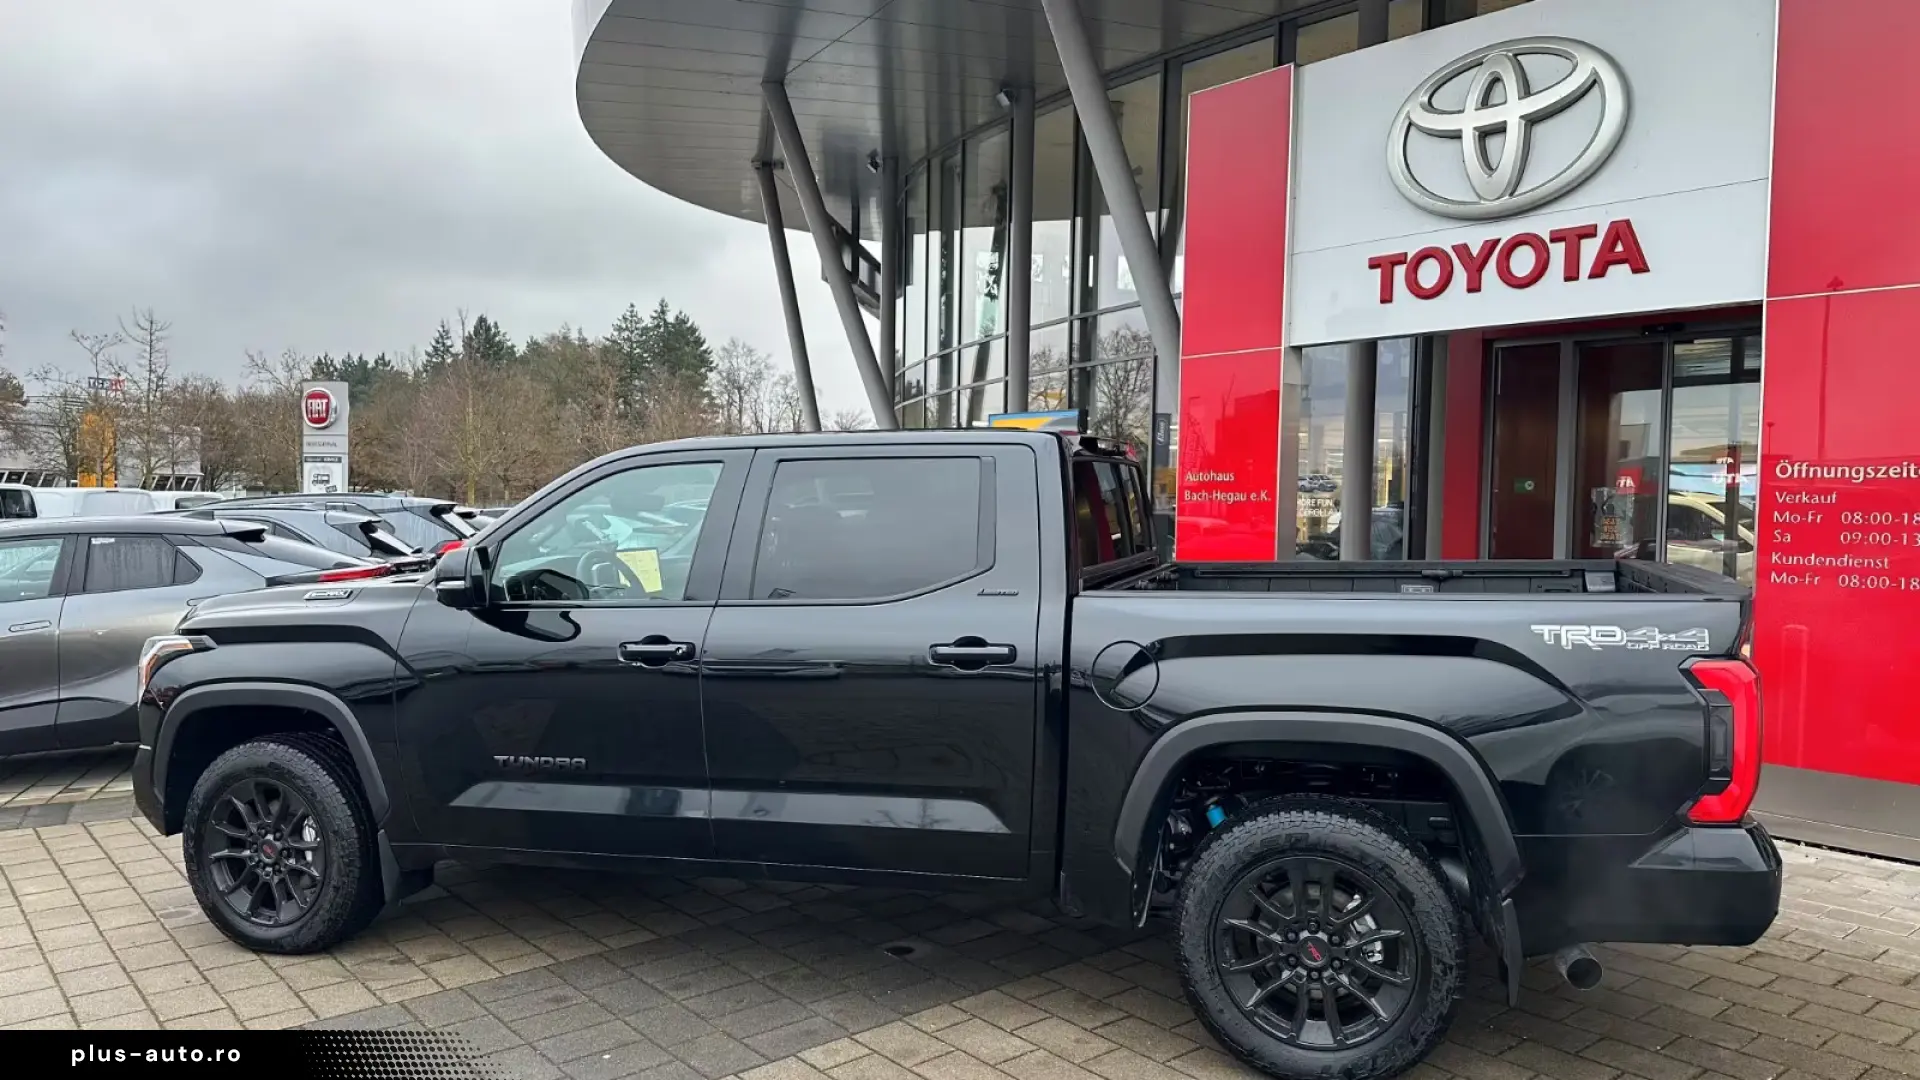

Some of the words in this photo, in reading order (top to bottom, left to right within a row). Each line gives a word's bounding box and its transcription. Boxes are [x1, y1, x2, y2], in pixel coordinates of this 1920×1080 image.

[1368, 219, 1650, 304] TOYOTA
[306, 398, 329, 418] FIAT
[1186, 470, 1235, 482] Autohaus
[1184, 489, 1247, 505] Bach-Hegau
[1250, 489, 1272, 502] e.K.
[1775, 491, 1837, 504] Verkauf
[1773, 510, 1824, 524] Mo-Fr
[1773, 529, 1792, 543] Sa
[1771, 551, 1890, 570] Kundendienst
[1770, 570, 1821, 586] Mo-Fr
[1838, 574, 1920, 591] 08:00-18
[1530, 624, 1627, 650] TRD
[1626, 642, 1660, 650] OFF
[1661, 642, 1710, 651] ROAD
[493, 755, 588, 771] TUNDRA
